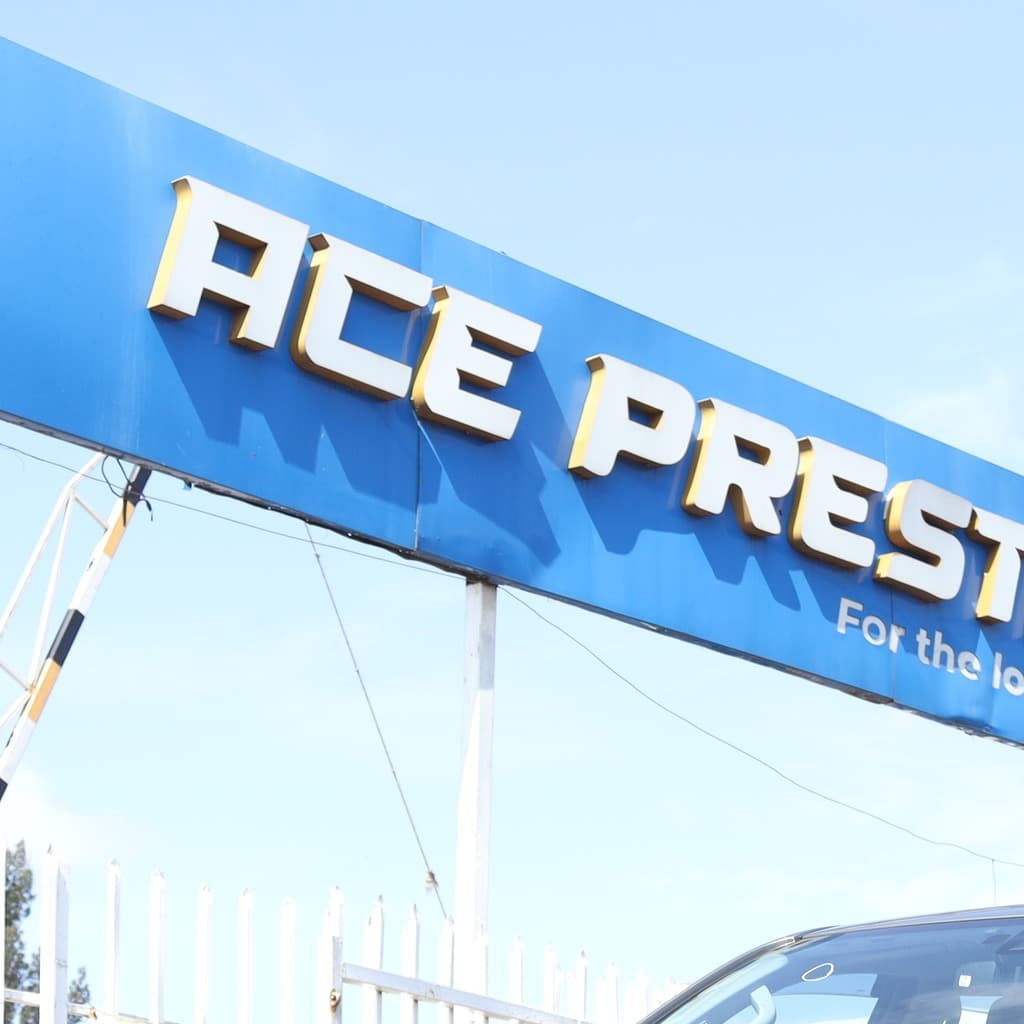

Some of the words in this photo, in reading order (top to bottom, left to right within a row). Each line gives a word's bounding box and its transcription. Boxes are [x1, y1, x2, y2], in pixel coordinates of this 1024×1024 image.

[147, 175, 543, 442] ACE
[836, 597, 906, 653] For
[916, 627, 982, 681] the
